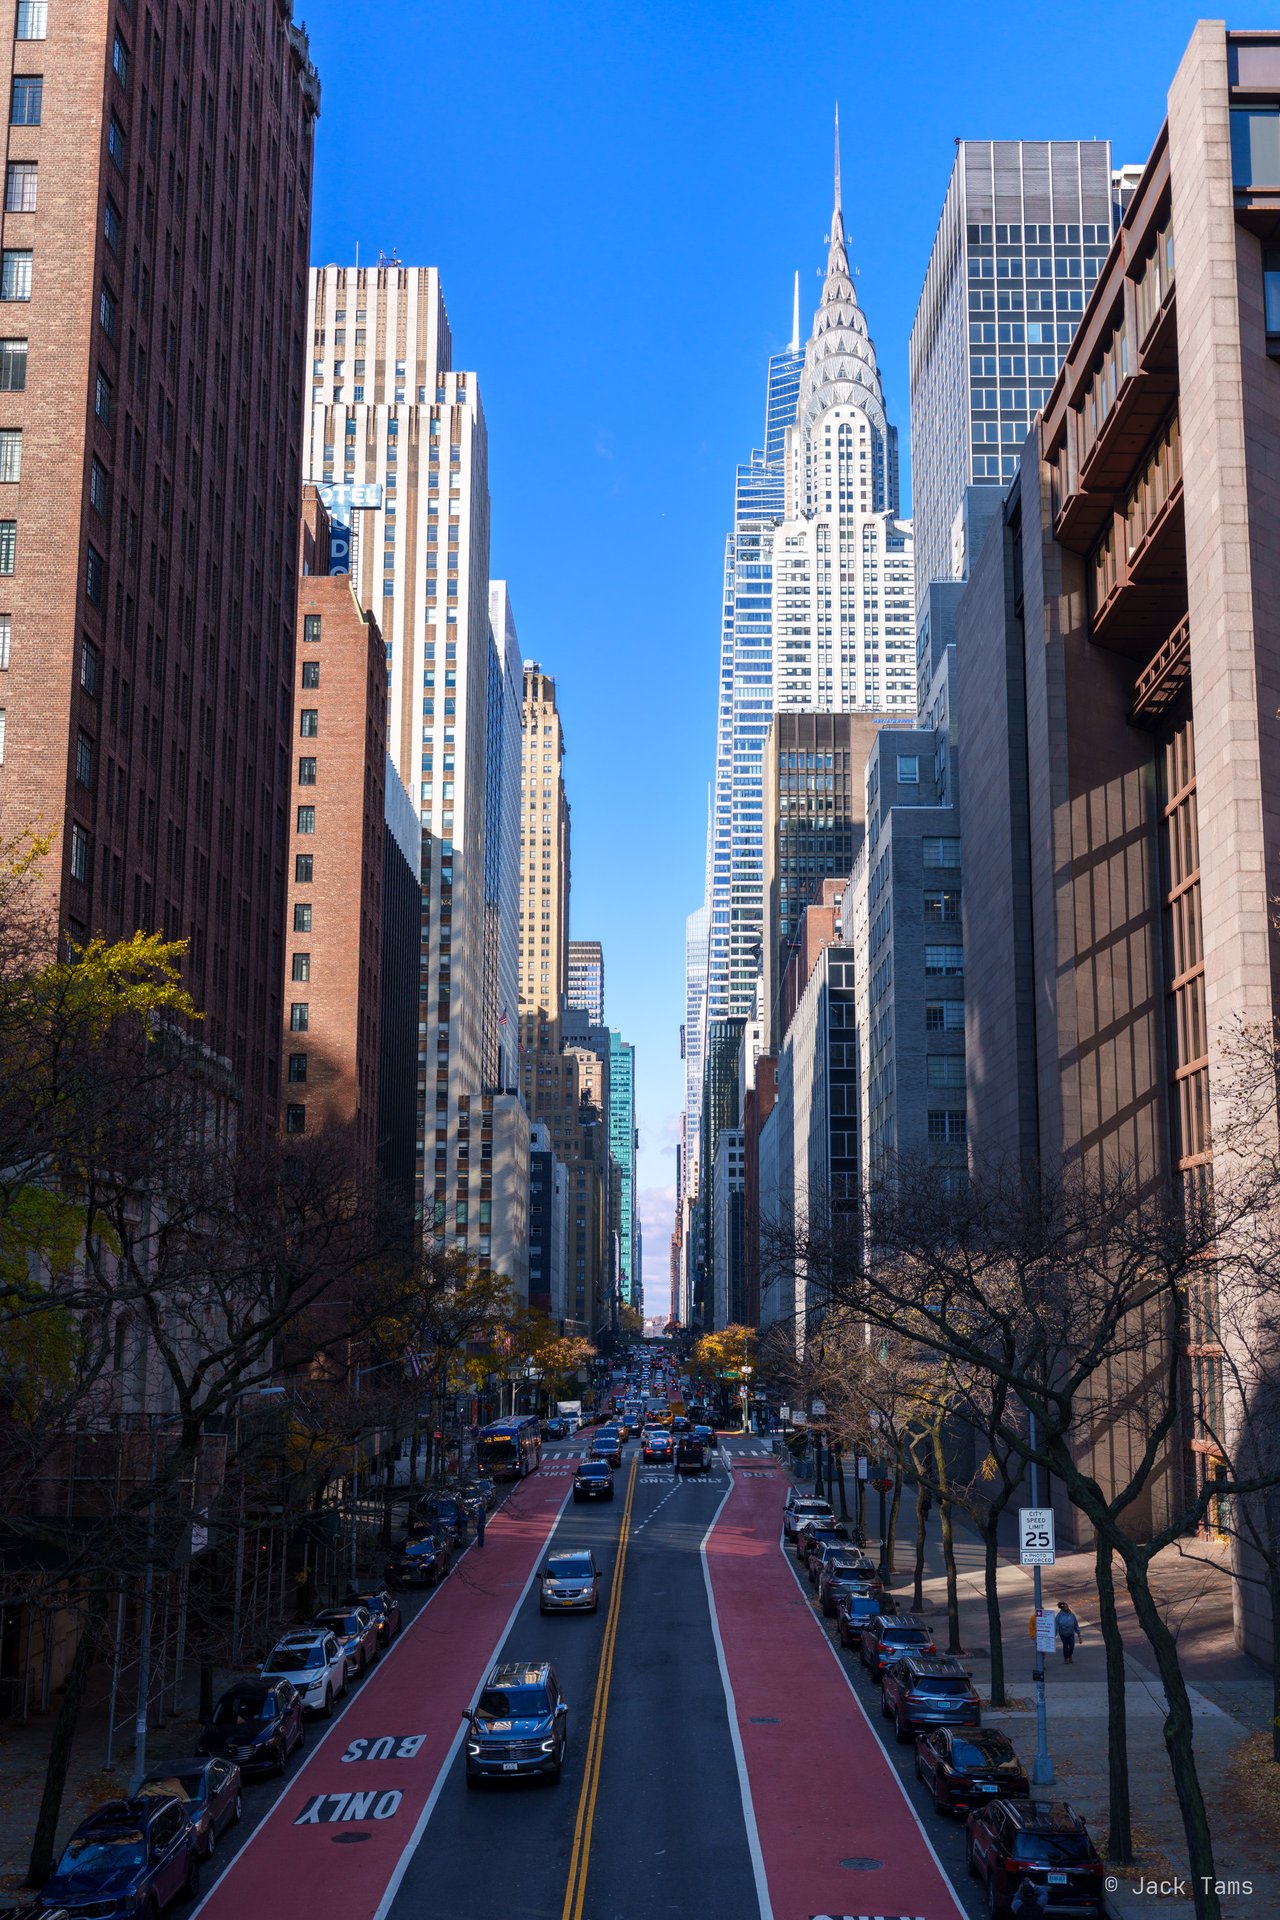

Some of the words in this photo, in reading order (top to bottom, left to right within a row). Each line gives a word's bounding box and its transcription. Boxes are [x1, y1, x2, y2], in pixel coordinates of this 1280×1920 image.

[319, 487, 378, 504] OTEL
[1025, 1531, 1050, 1547] 25
[341, 1734, 427, 1763] BUS
[293, 1790, 403, 1825] ONLY
